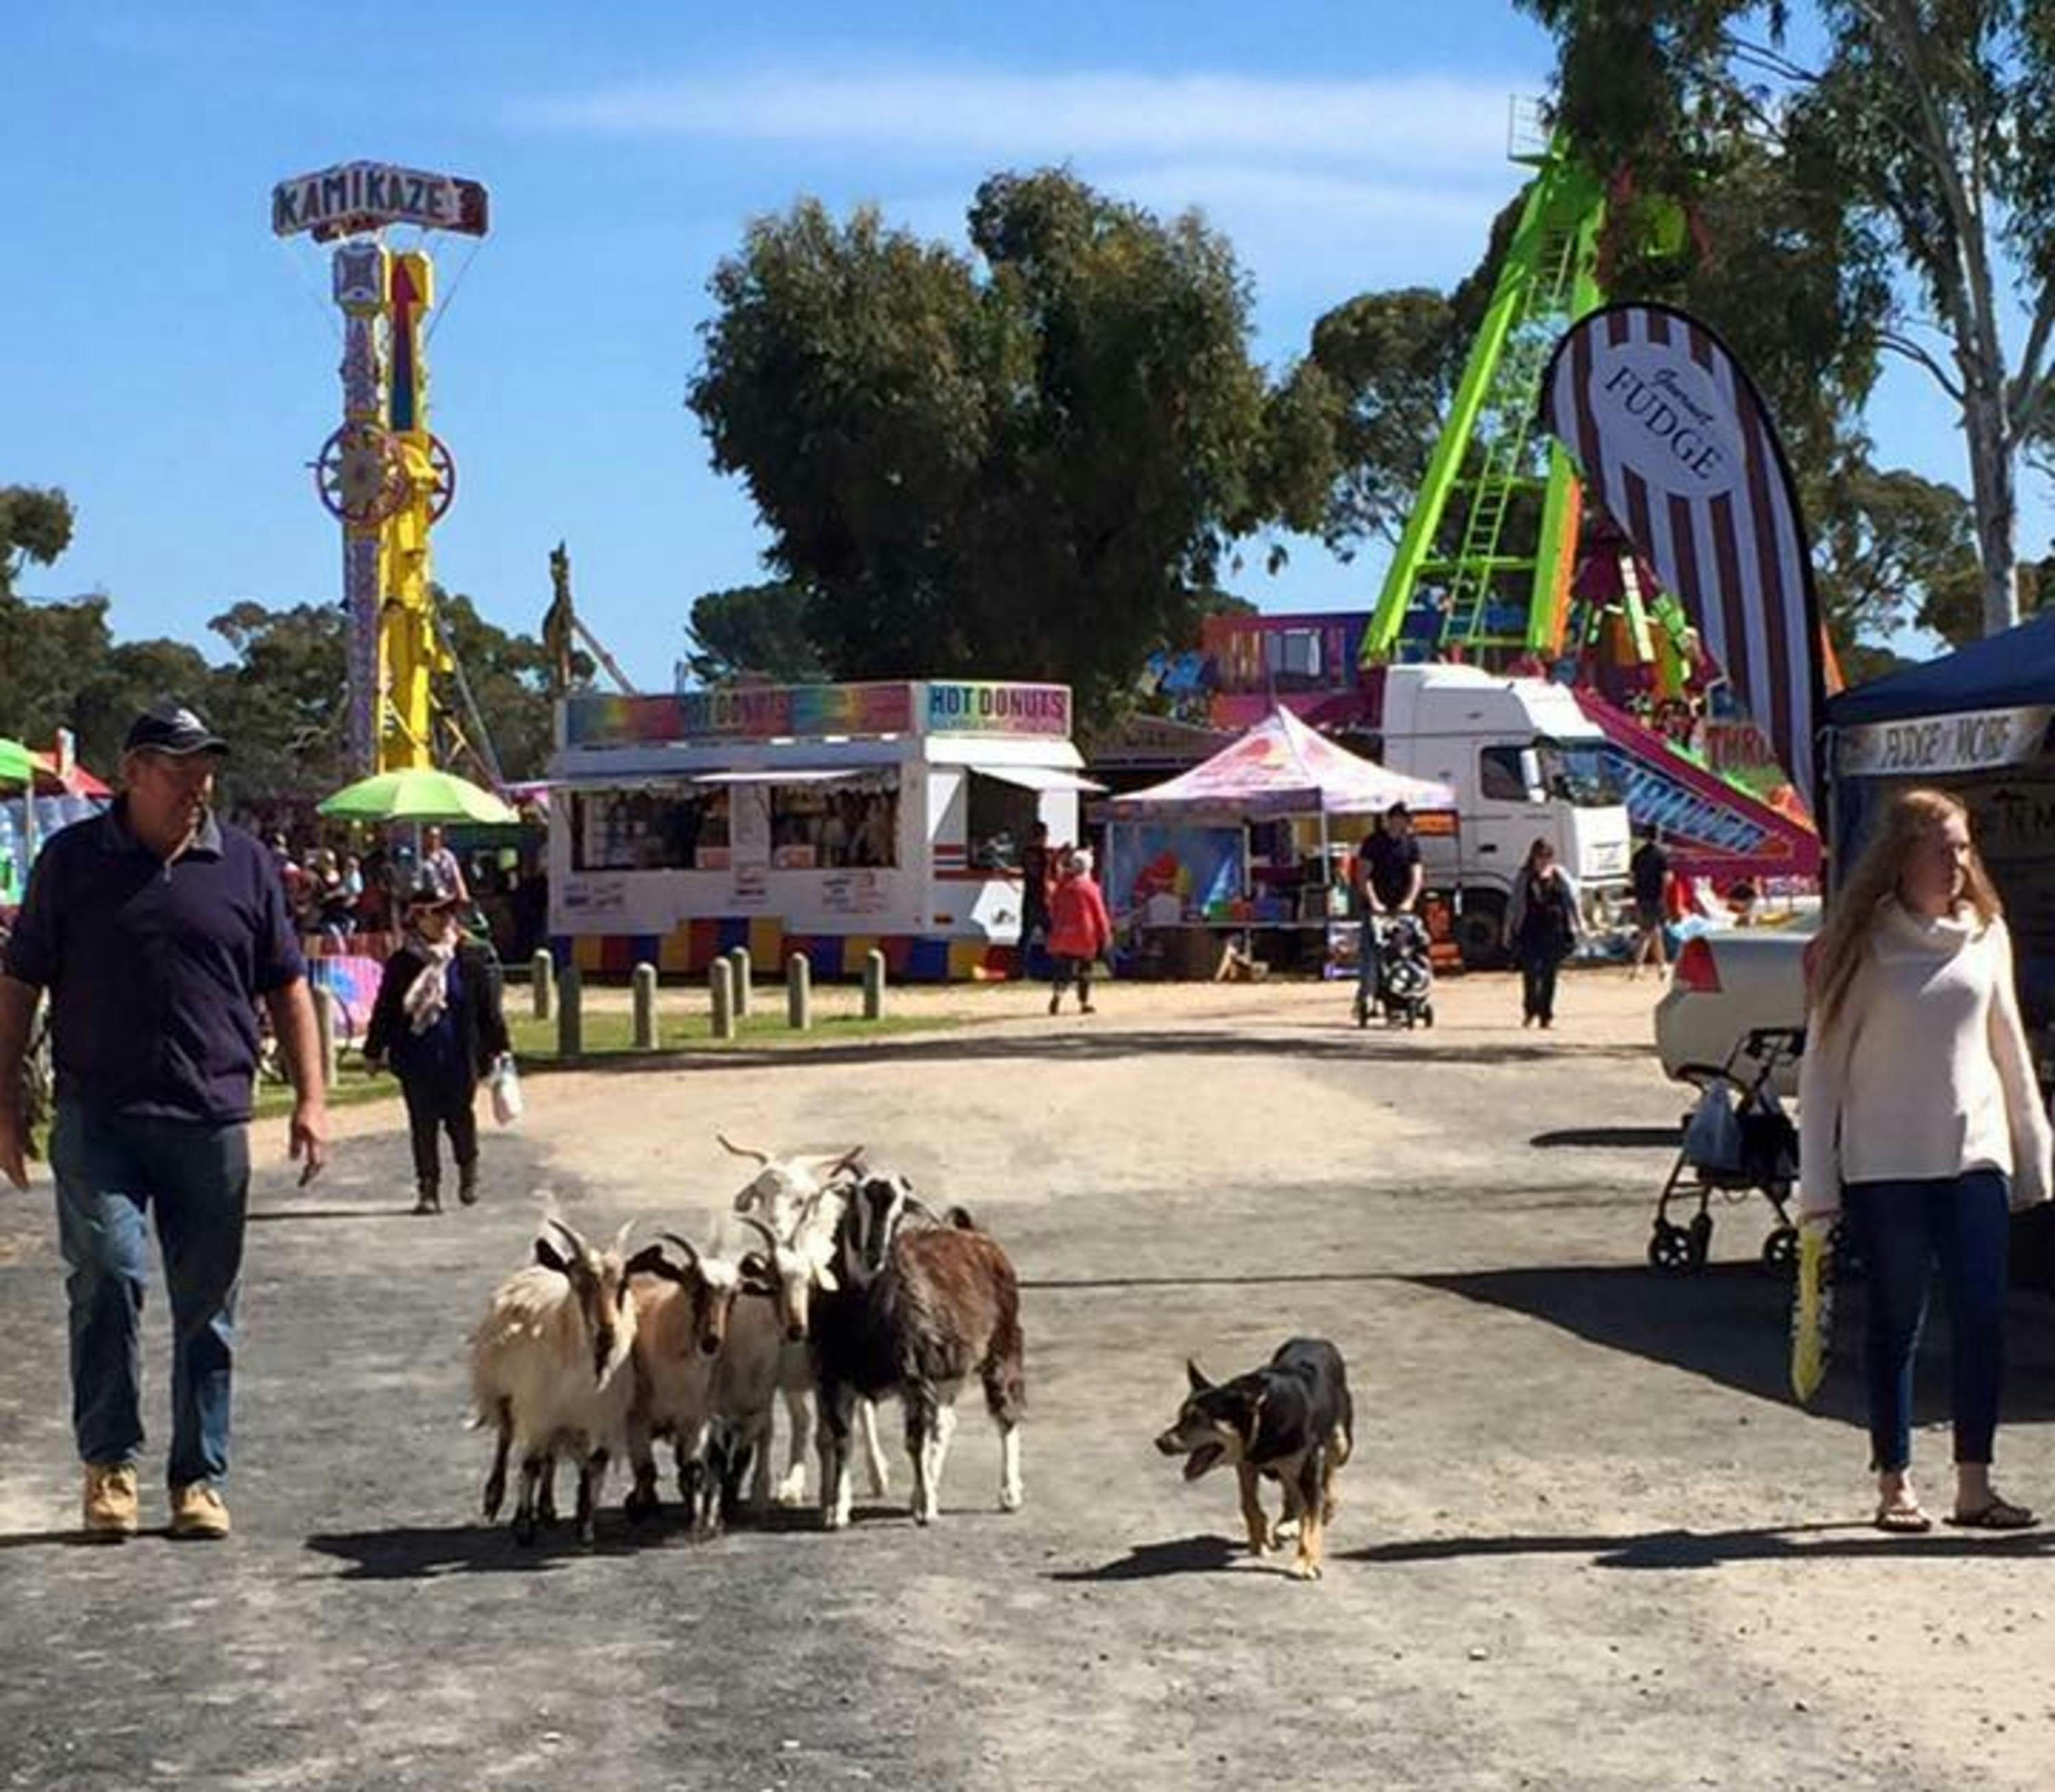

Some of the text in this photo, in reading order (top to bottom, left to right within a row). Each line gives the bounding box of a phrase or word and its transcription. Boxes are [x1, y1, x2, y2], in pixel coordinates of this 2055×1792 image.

[275, 169, 446, 227] KAMIKAZE
[1604, 366, 1722, 480] FUDGE
[930, 684, 1065, 719] HOT DONUTS
